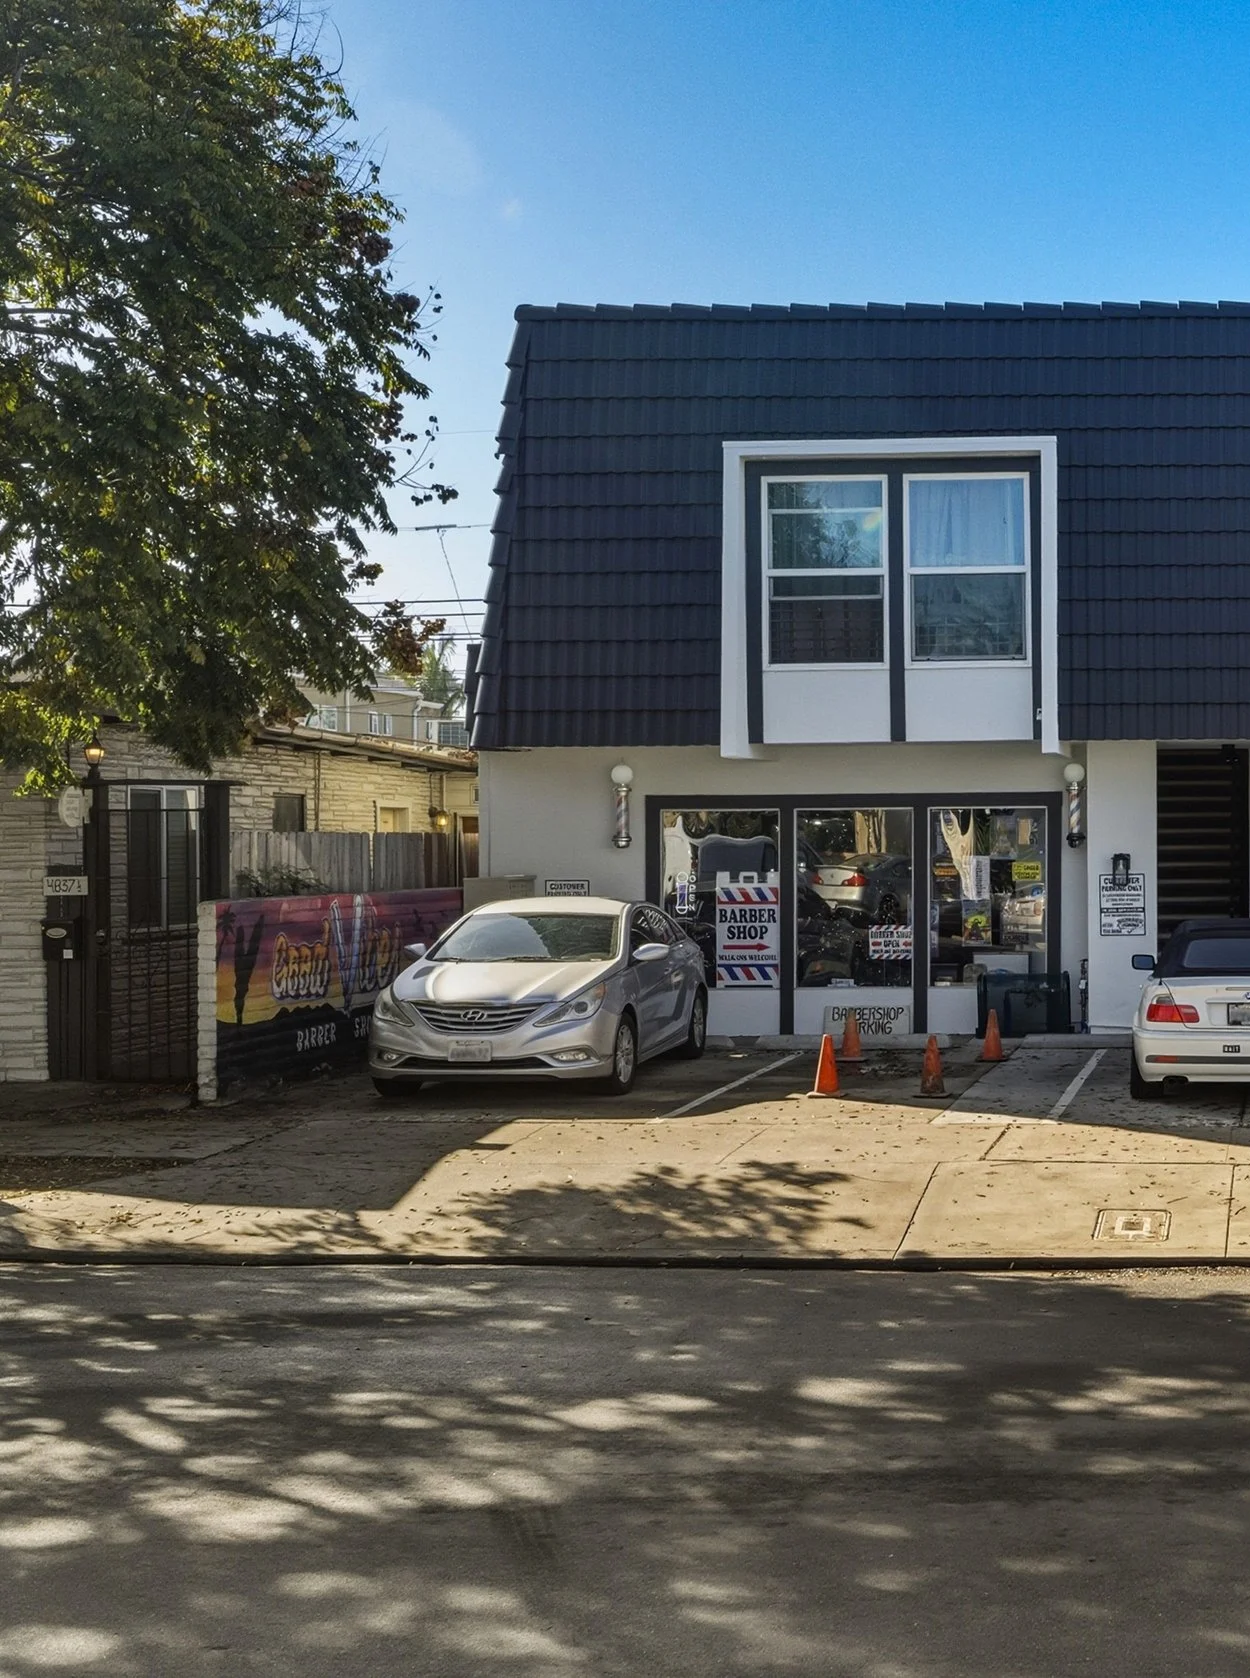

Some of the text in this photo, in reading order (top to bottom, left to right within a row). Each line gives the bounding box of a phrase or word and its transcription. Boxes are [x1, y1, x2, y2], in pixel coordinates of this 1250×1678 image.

[689, 875, 697, 911] OPEN
[718, 908, 777, 924] BARBER
[726, 925, 769, 940] SHOP
[883, 940, 900, 948] OPEN
[296, 1016, 373, 1052] BARBER SHO
